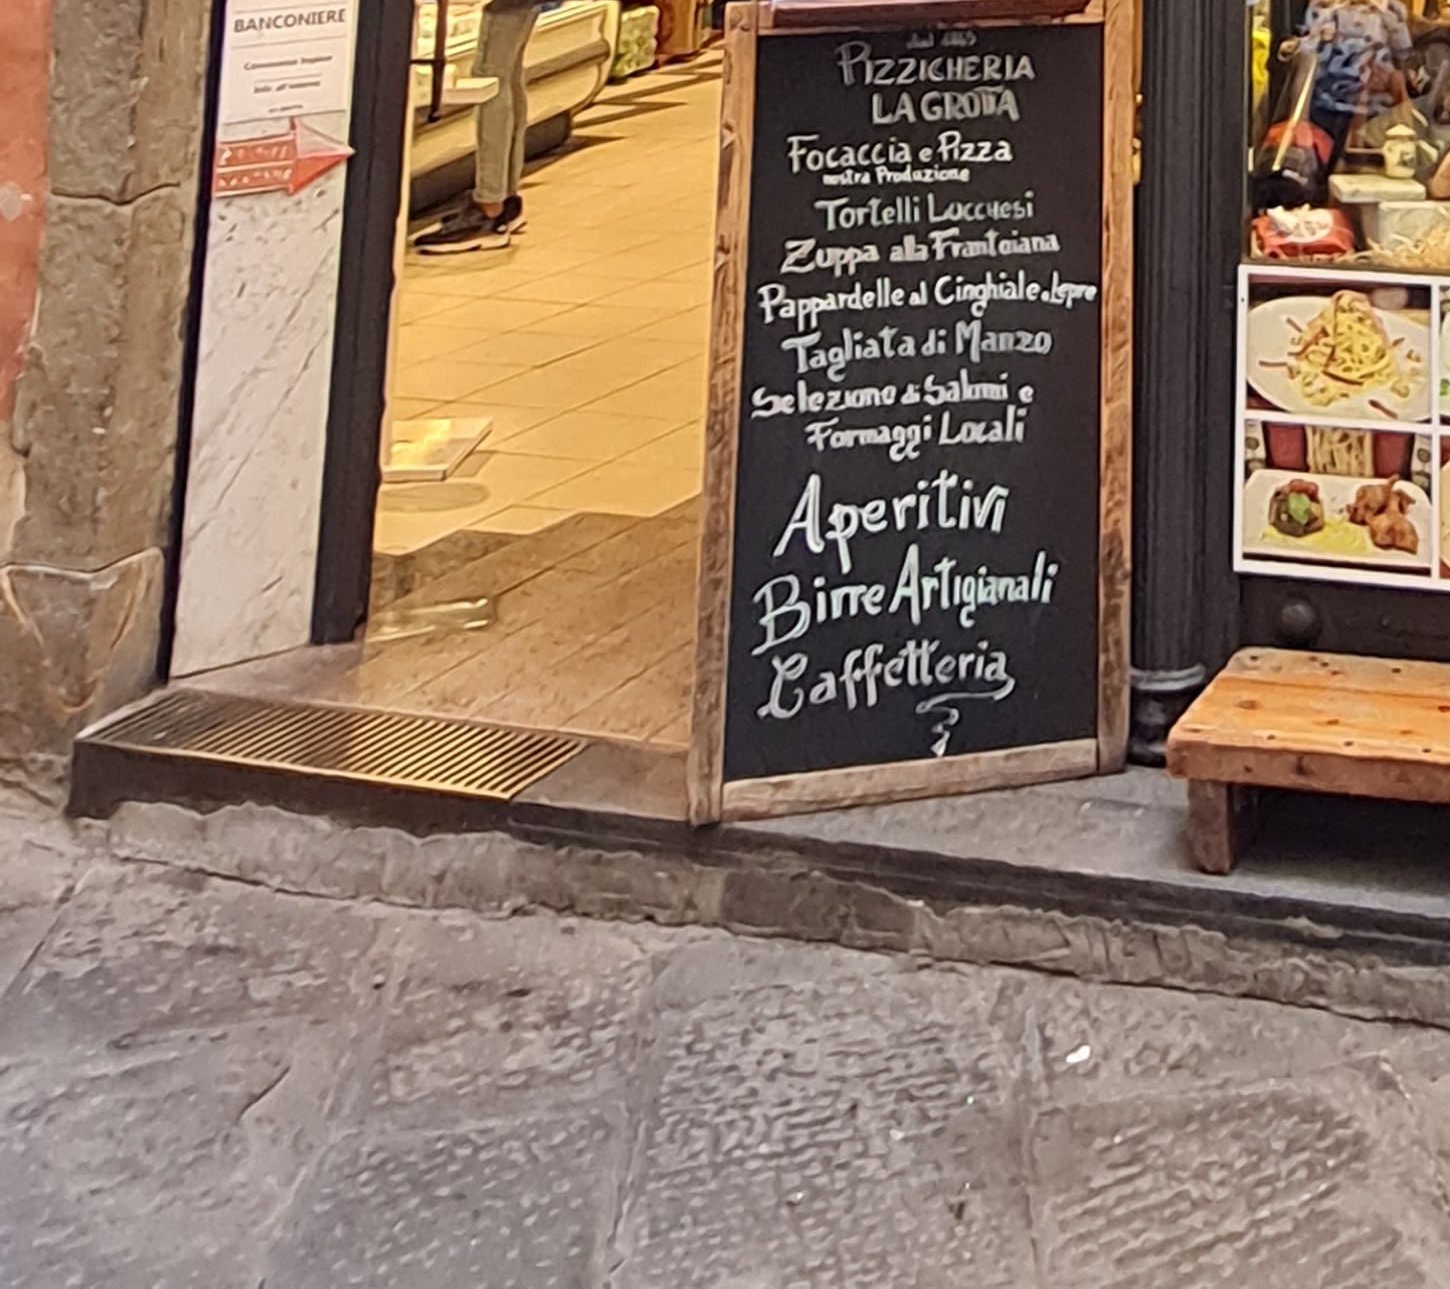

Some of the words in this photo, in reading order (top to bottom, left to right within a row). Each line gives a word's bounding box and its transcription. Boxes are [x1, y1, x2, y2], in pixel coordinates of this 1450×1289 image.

[234, 8, 347, 33] BANCONIERE
[836, 40, 1036, 87] PIZZICHERIA
[871, 92, 916, 124] LA
[921, 85, 1021, 122] GROTTA
[786, 133, 912, 174] Focaccia
[918, 147, 933, 163] e
[938, 130, 1013, 163] Pizza
[876, 166, 970, 185] Produzione
[814, 194, 921, 231] Tortelli
[780, 238, 880, 278] Zuppa
[889, 234, 929, 263] alla
[757, 277, 905, 332] Pappardelle
[909, 280, 929, 307] al
[934, 269, 1041, 317] Cinghiale
[781, 325, 916, 382] Tagliata
[921, 329, 947, 356] di
[955, 320, 1054, 363] Manzo
[751, 380, 897, 419] Selezione
[924, 368, 1010, 406] Salumi
[1018, 384, 1034, 403] e
[805, 415, 932, 461] Formaggi
[938, 404, 1028, 445] Locali
[773, 469, 1009, 574] Aperitivi
[751, 574, 887, 657] Birre
[889, 543, 1059, 628] Artigianali
[757, 640, 1016, 720] Caffetteria
